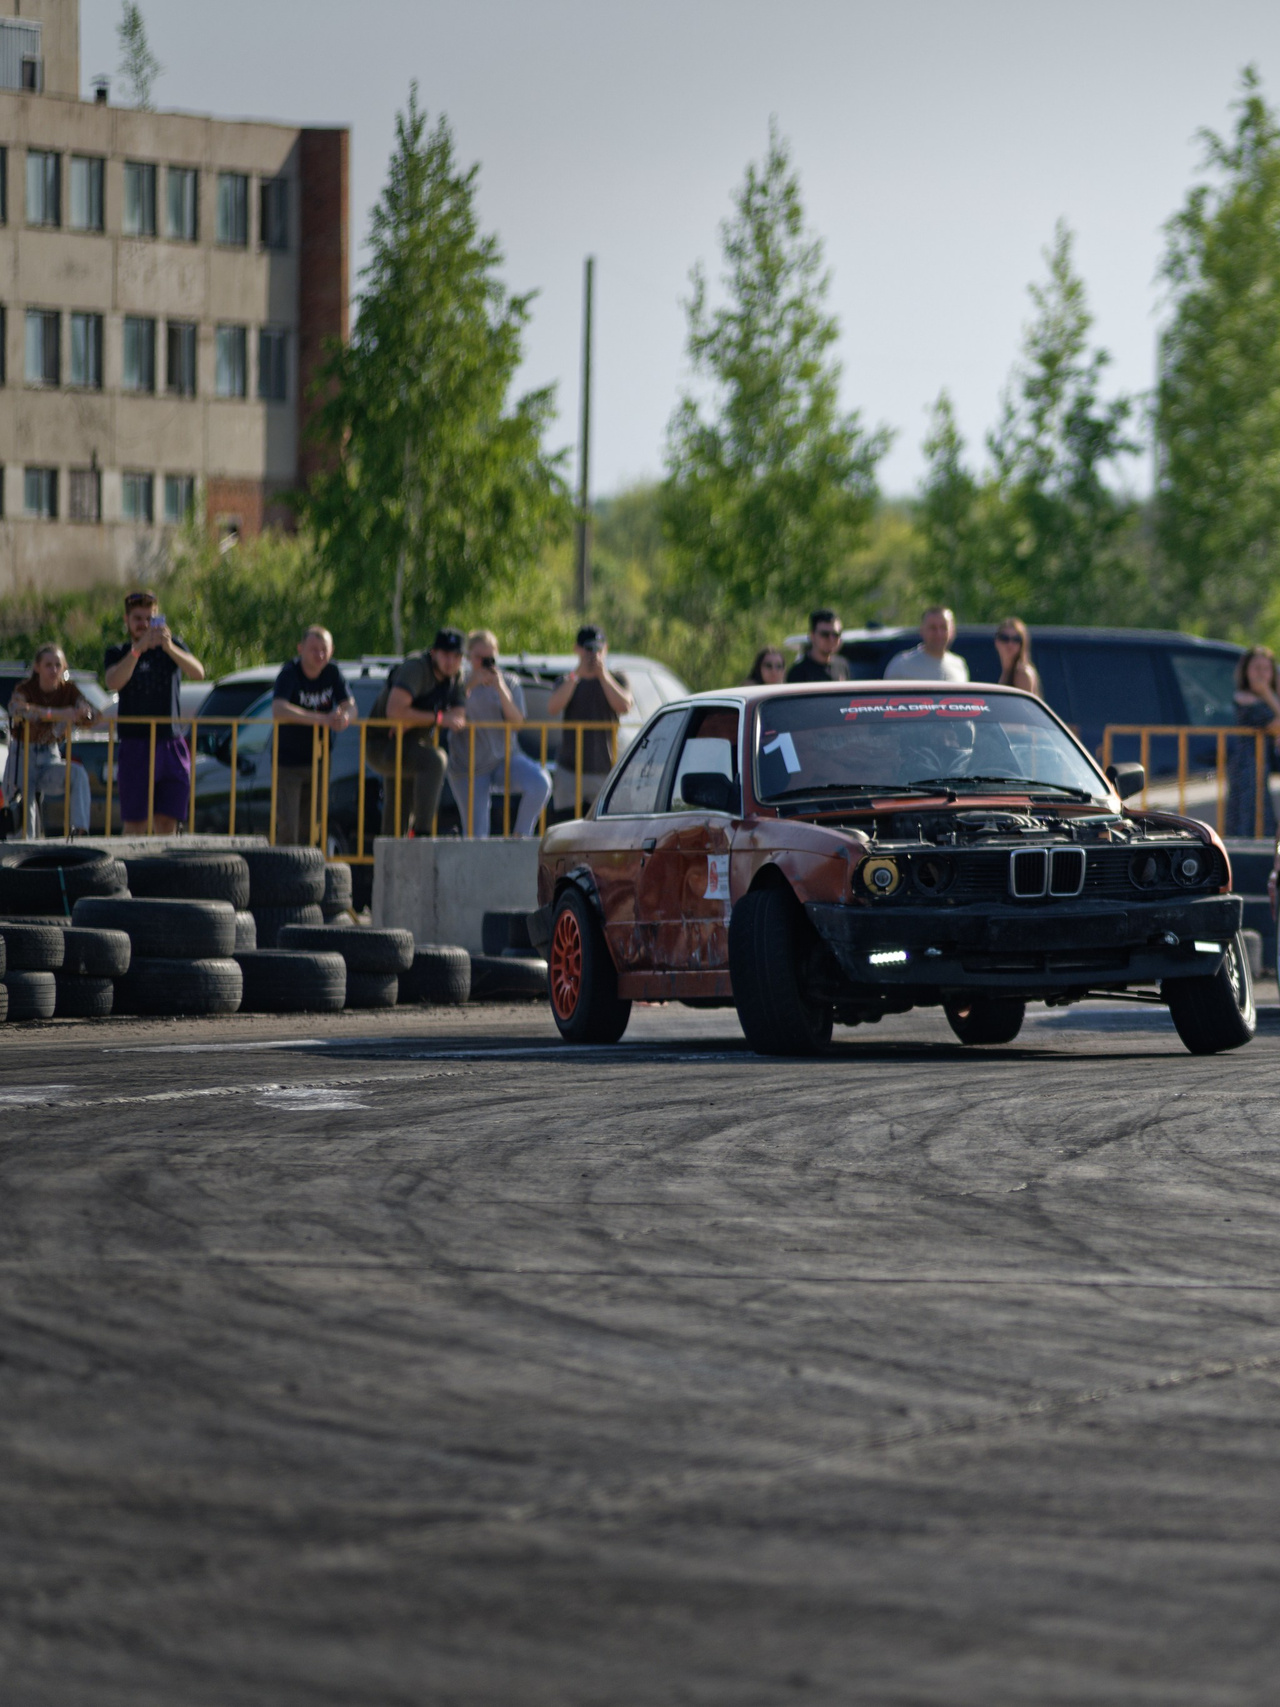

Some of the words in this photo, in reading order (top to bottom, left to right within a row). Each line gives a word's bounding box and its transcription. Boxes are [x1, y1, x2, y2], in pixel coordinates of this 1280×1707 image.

[839, 704, 908, 715] FORMULA
[908, 704, 948, 712] DRIFT
[948, 704, 991, 712] OMSK
[762, 731, 802, 774] 1
